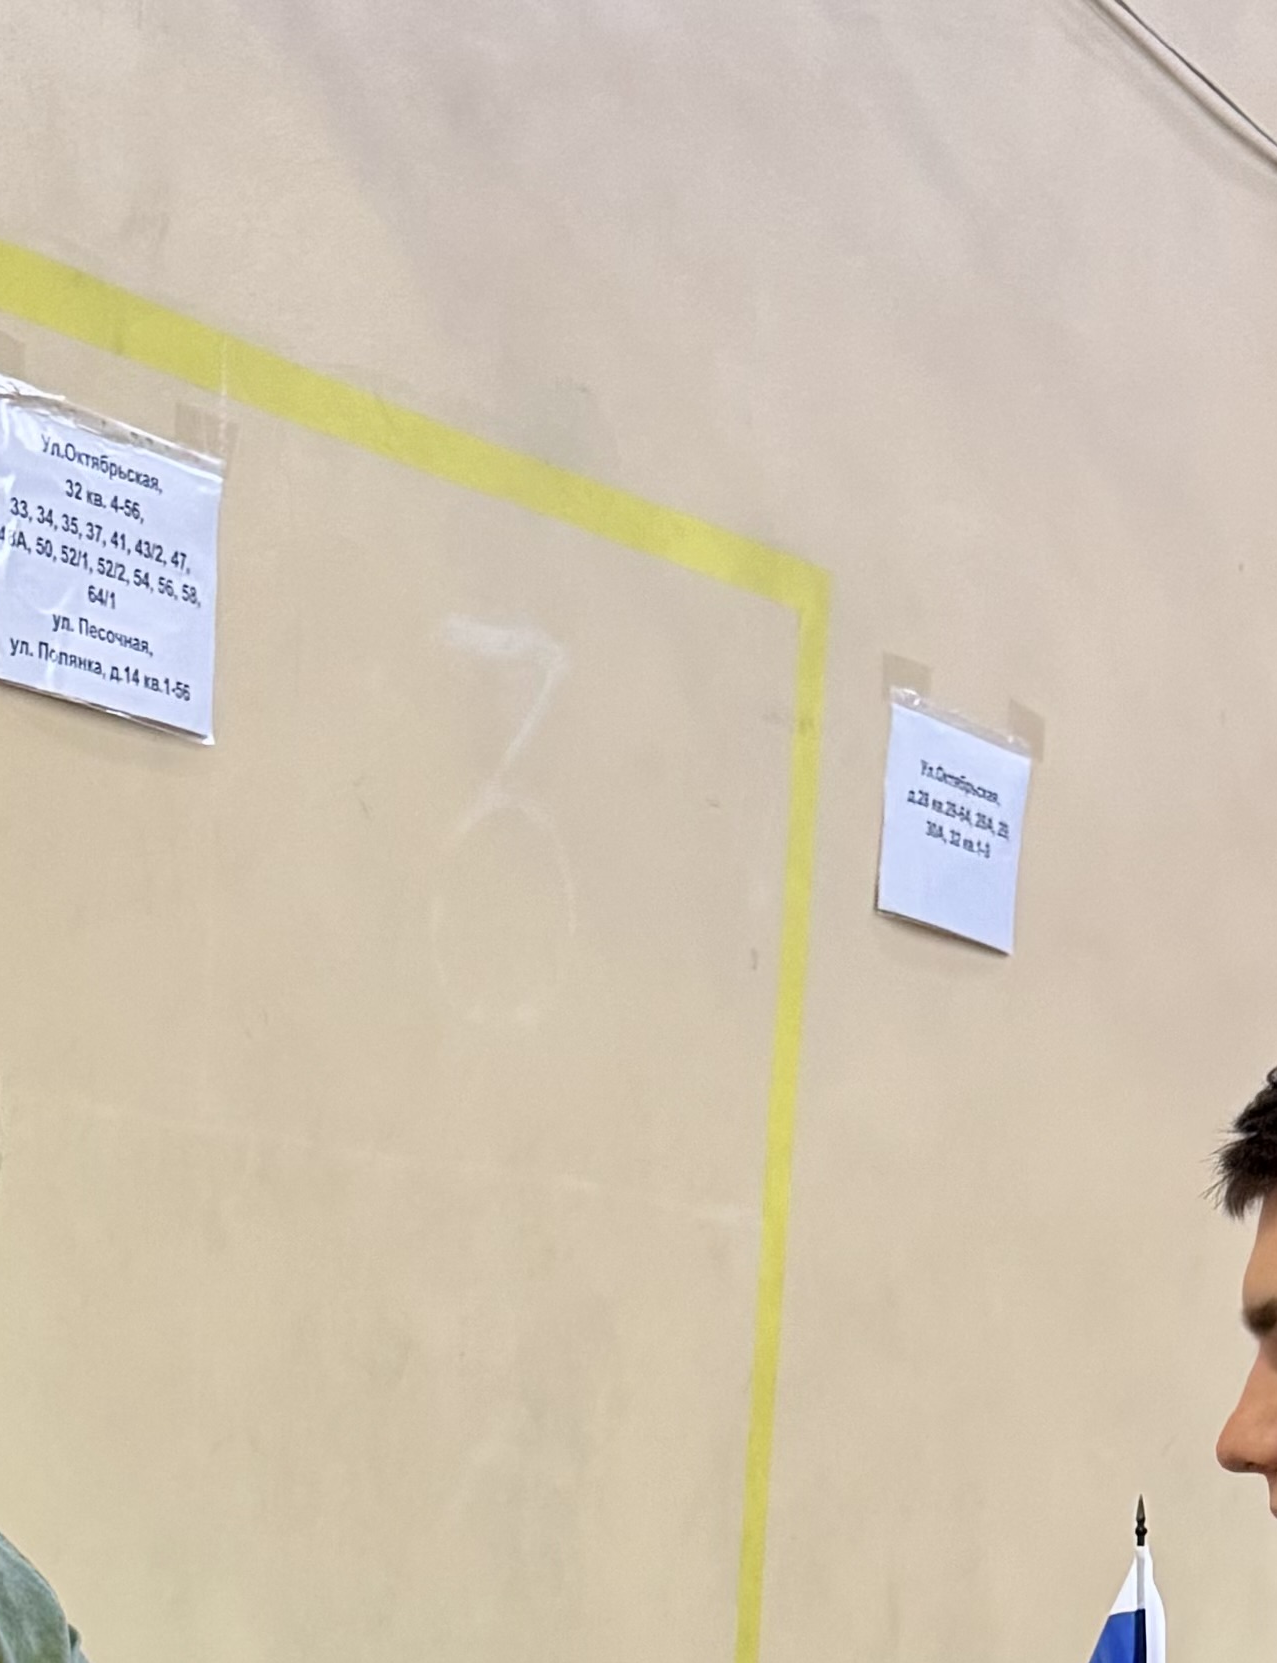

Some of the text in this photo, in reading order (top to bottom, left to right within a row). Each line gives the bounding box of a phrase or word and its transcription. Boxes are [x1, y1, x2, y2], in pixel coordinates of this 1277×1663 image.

[41, 434, 163, 494] Ул.Октябрьская,
[65, 479, 144, 524] 32 кв. 4-56,
[10, 497, 191, 575] 33, 34, 35, 37, 41, 43/2, 47,
[35, 537, 57, 562] 50,
[60, 545, 93, 575] 52/1,
[97, 557, 130, 585] 52/2,
[133, 568, 154, 593] 54,
[158, 576, 179, 601] 56,
[182, 584, 201, 608] 58,
[88, 585, 116, 609] 64/1
[52, 613, 153, 657] ул. Песочная,
[9, 637, 34, 657] ул.
[109, 665, 140, 686] д.14
